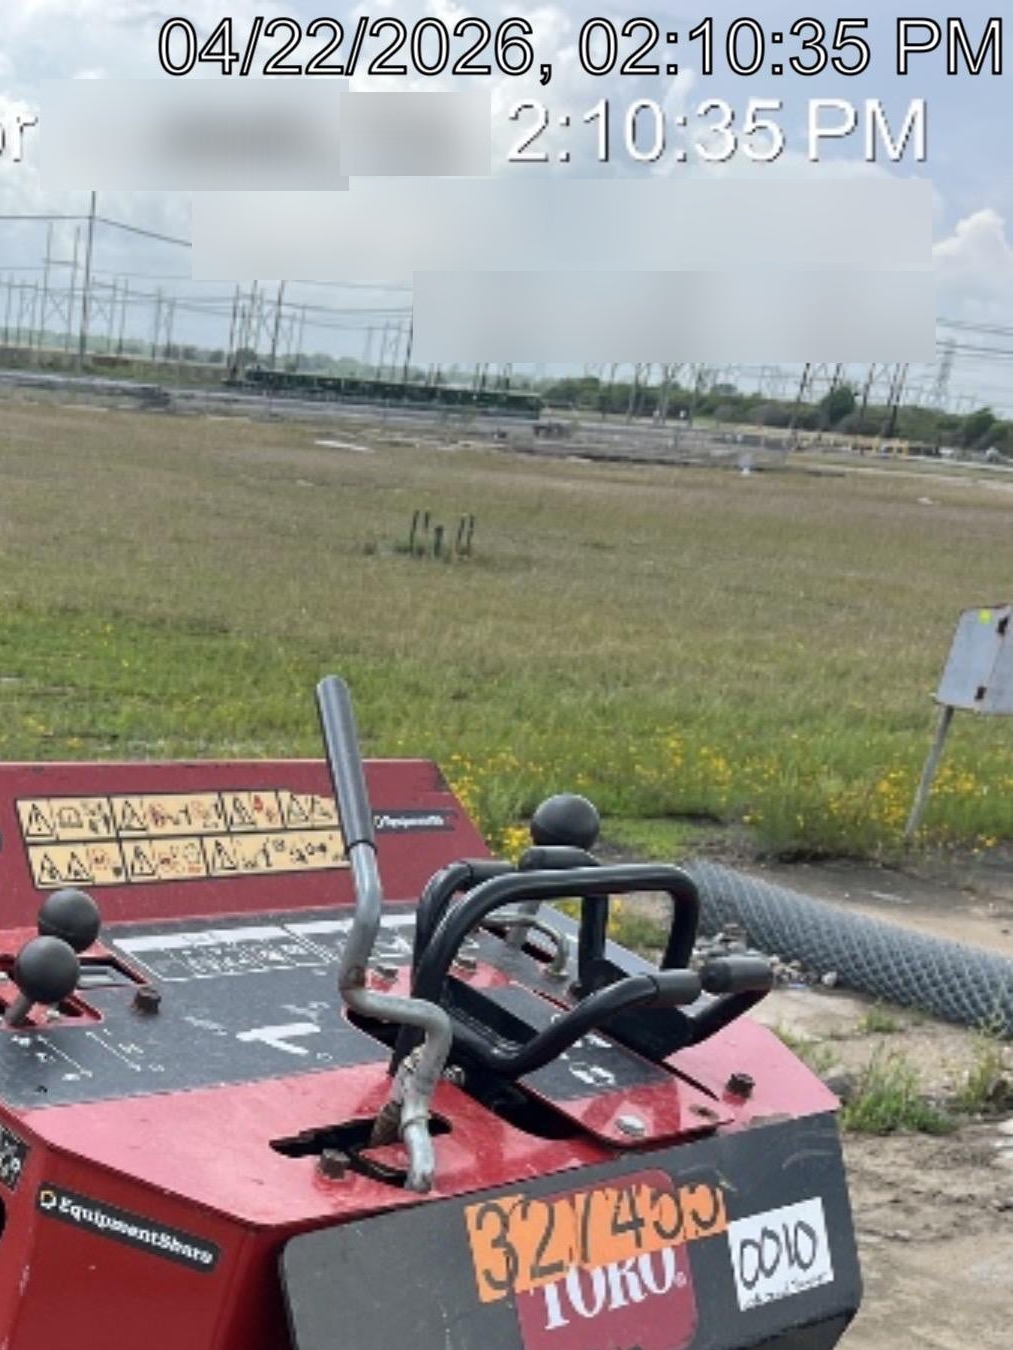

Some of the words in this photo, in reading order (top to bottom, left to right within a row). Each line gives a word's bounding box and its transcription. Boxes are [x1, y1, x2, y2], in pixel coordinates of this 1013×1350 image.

[58, 1196, 213, 1265] EquipmentShare
[740, 1220, 817, 1290] 0010
[529, 1245, 677, 1330] TORO
